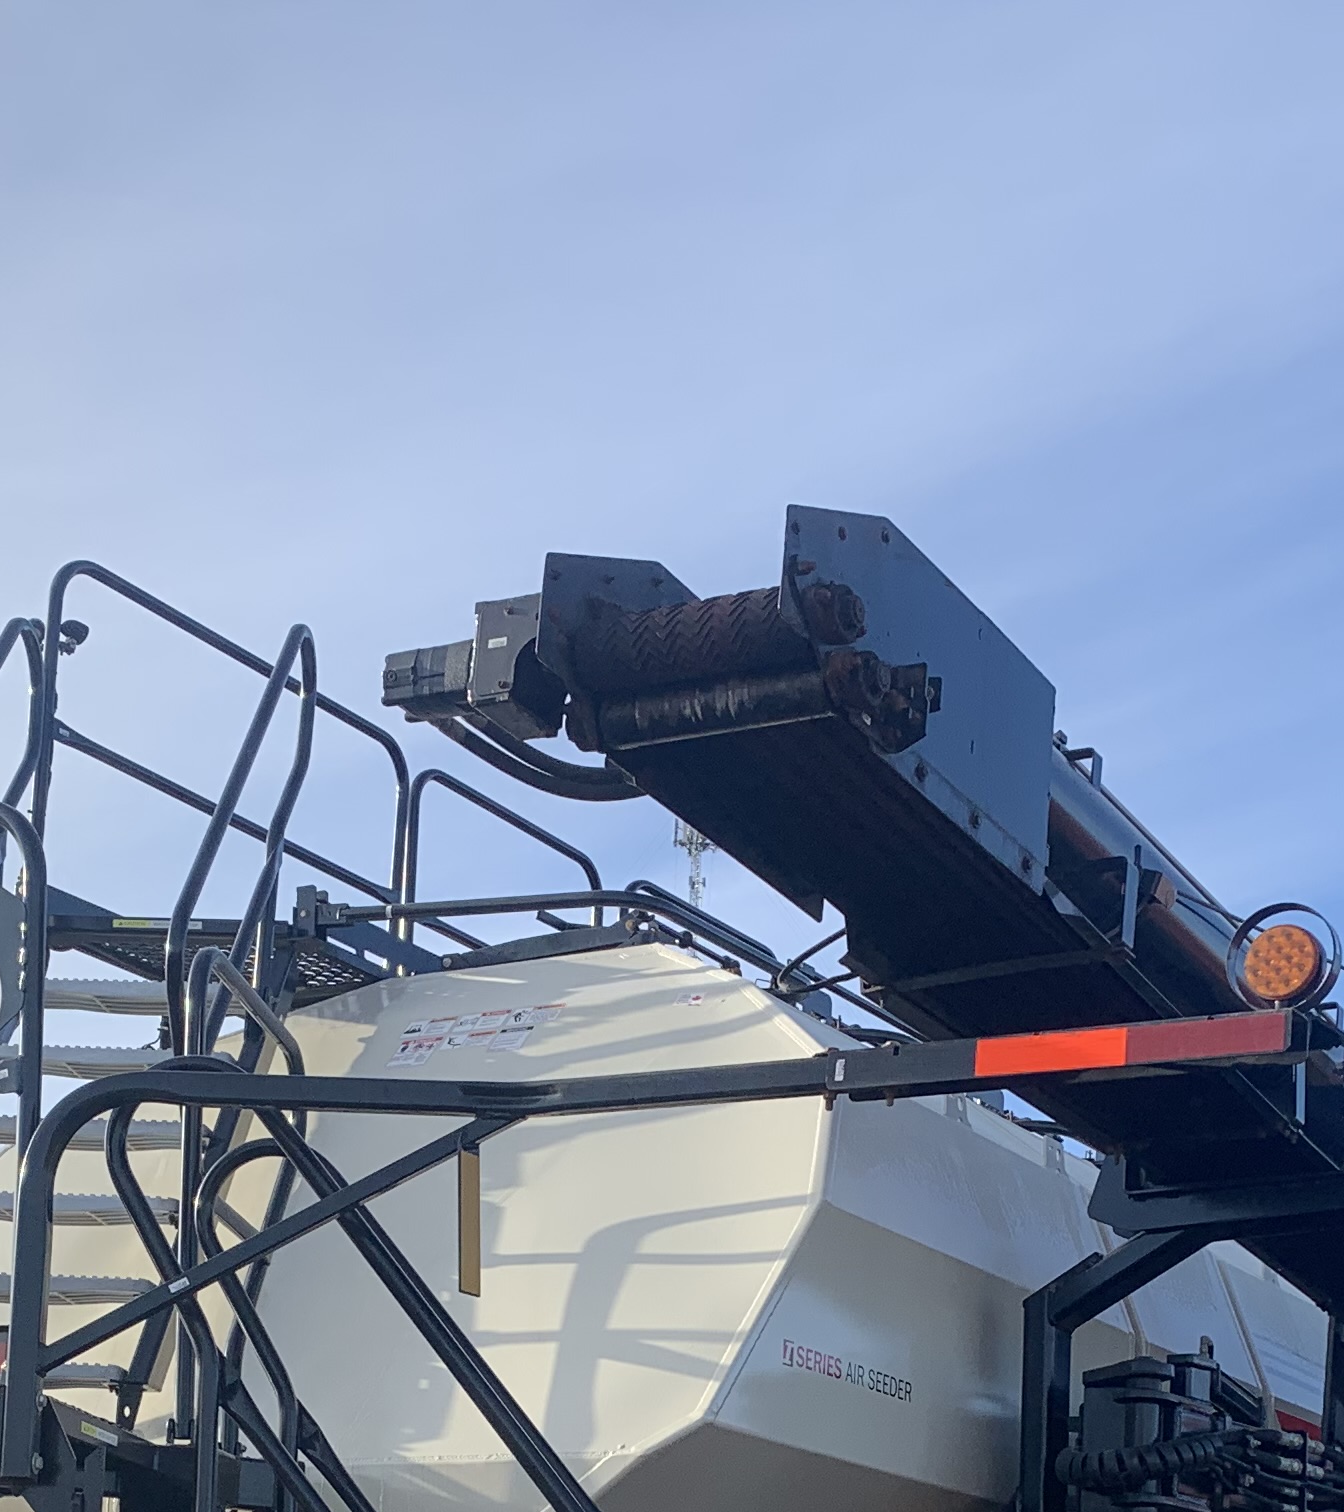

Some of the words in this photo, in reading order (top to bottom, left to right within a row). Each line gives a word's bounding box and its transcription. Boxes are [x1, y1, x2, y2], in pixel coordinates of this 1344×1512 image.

[796, 1346, 842, 1379] SERIES
[845, 1362, 864, 1387] AIR
[868, 1369, 912, 1403] SEEDER
